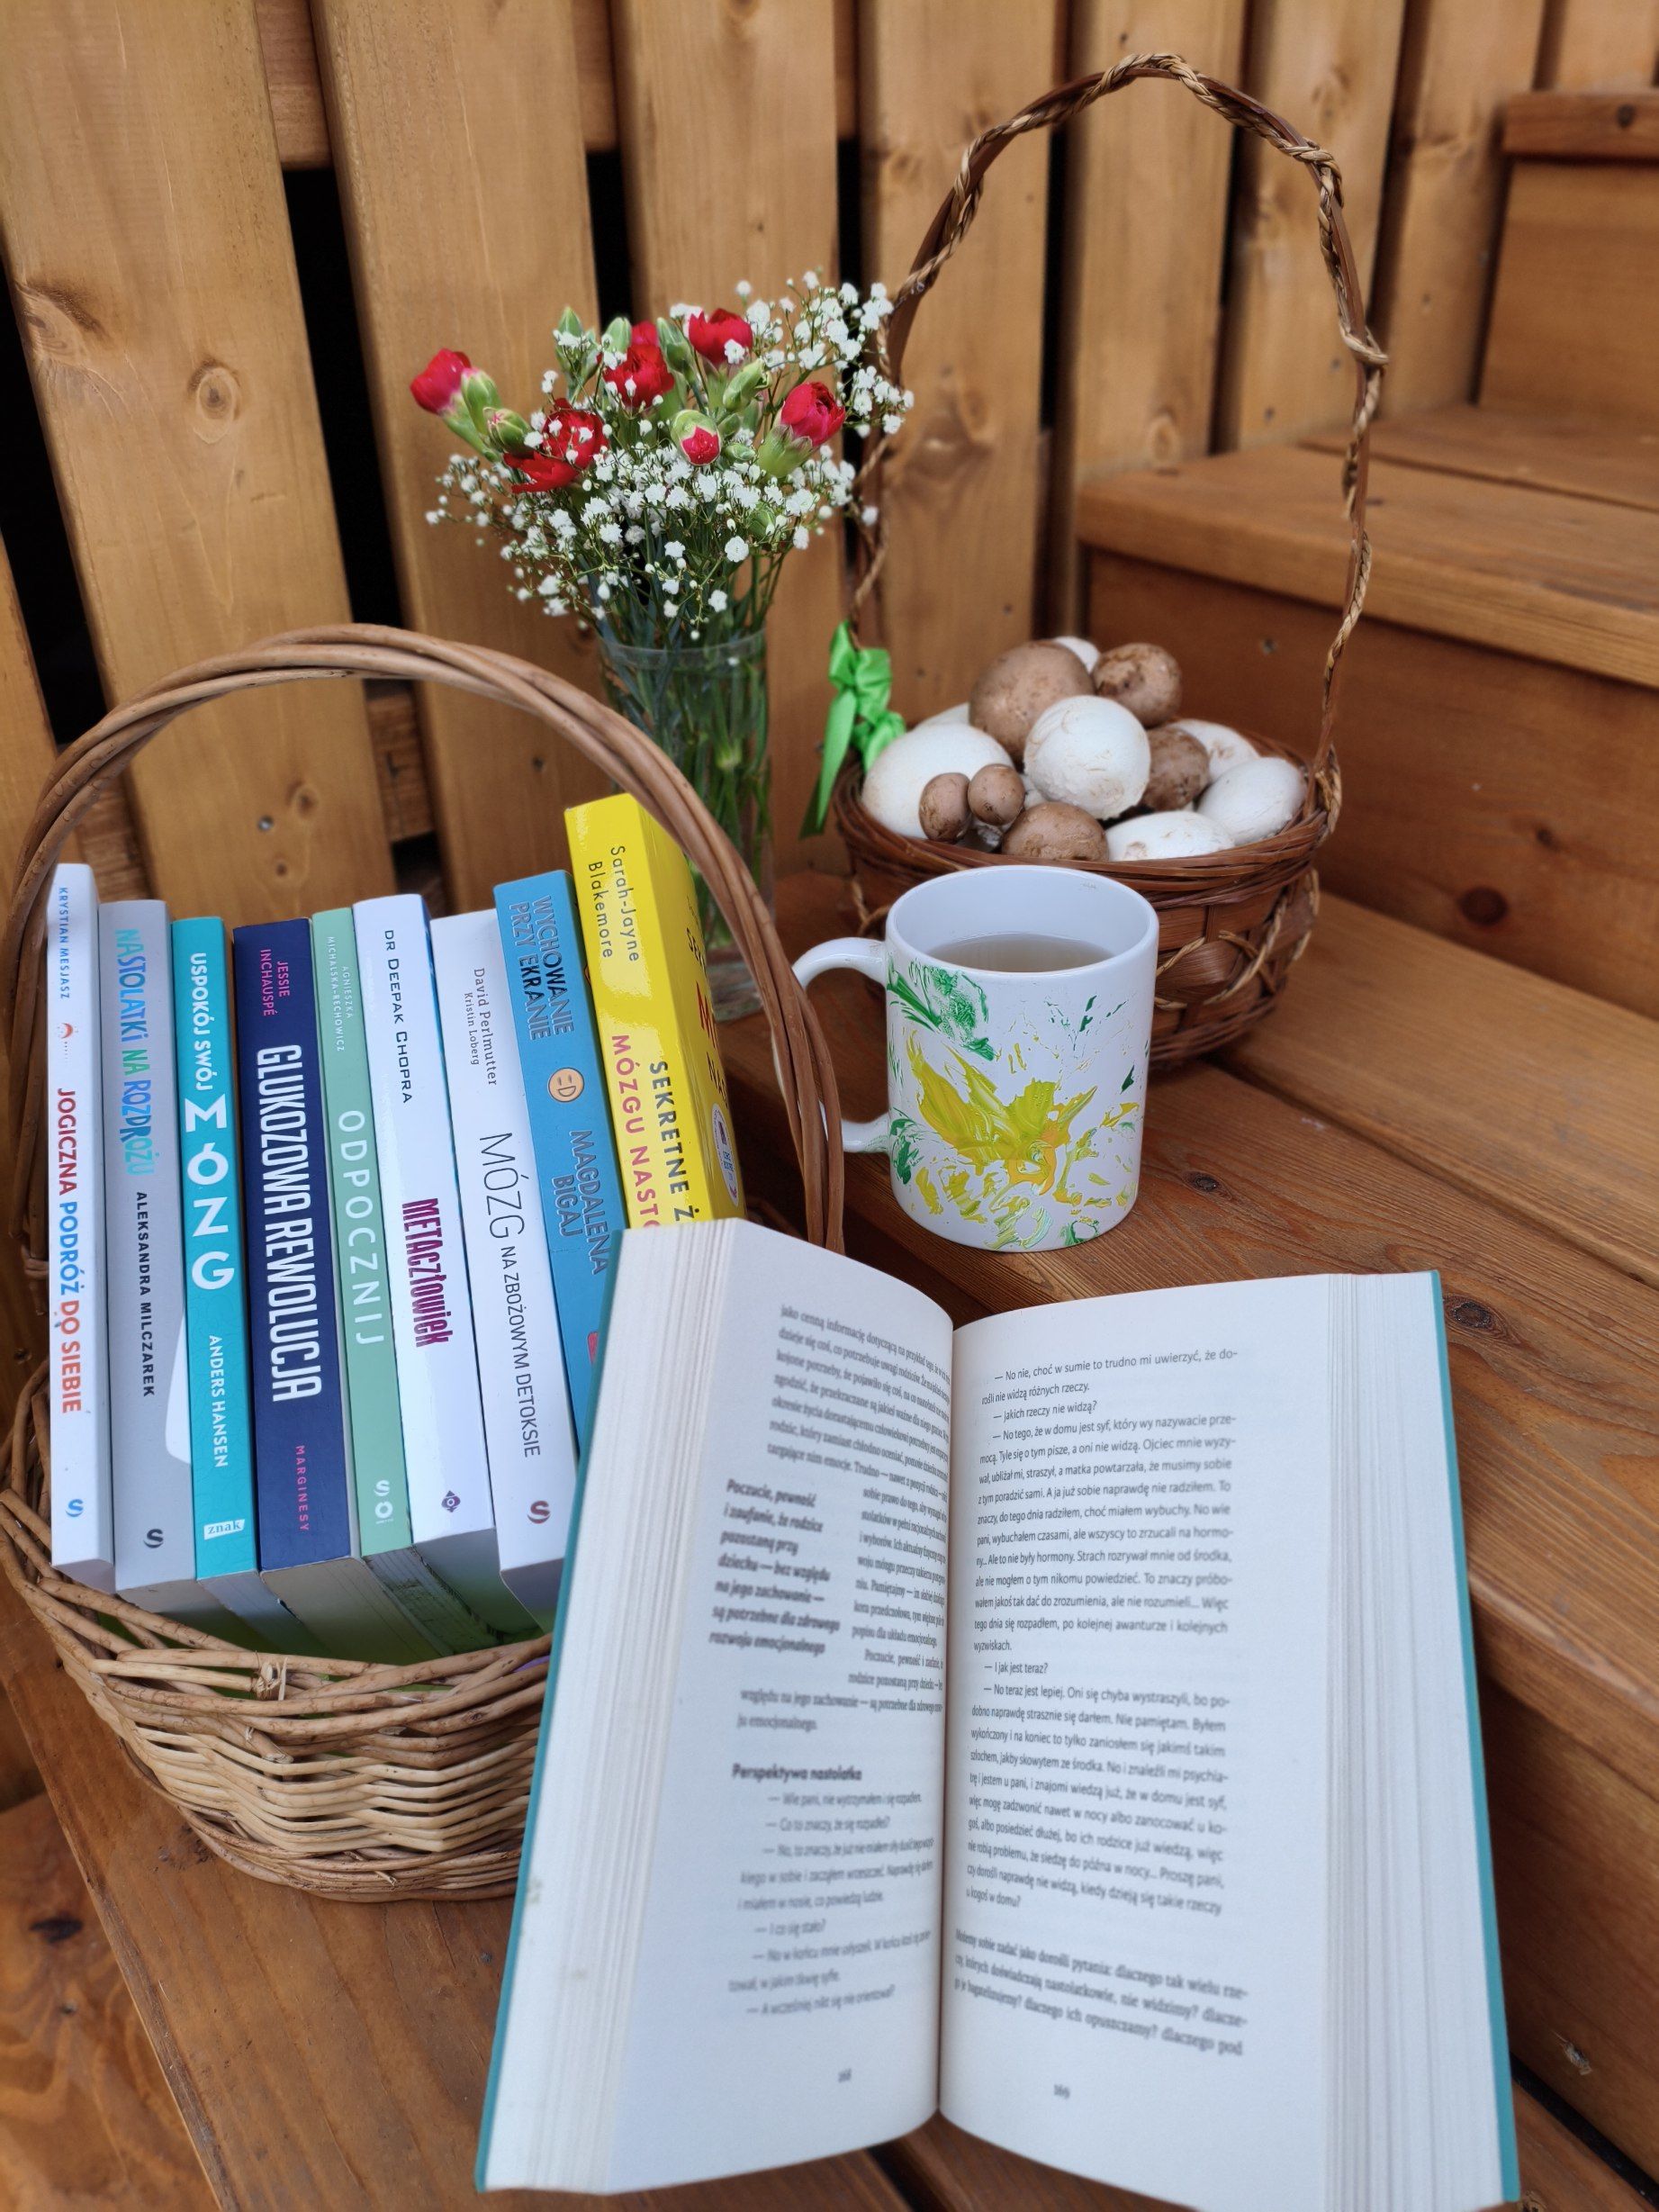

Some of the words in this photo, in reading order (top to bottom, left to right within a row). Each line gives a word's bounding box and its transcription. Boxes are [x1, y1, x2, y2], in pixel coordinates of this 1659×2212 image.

[58, 887, 69, 943] KRYSTIAN
[510, 902, 534, 948] PRZY
[588, 861, 613, 958] Blakemore
[610, 845, 640, 962] Sarah-Jayne
[384, 929, 396, 951] DR
[532, 895, 573, 1036] WYCHOWANIE
[60, 946, 71, 999] MESJASZ
[189, 952, 215, 1035] USPOKÓJ
[260, 949, 278, 1016] INCHAUSPÉ
[277, 960, 290, 997] JESSIE
[326, 936, 345, 1052] MICHALSKA-RECHOWICZ
[342, 966, 352, 1019] AGNIESZKA
[387, 958, 405, 1024] DEEPAK
[474, 967, 488, 1007] David
[519, 953, 551, 1041] EKRANIE
[463, 992, 475, 1030] Kristin
[121, 1050, 150, 1076] NA
[194, 1040, 213, 1091] SWÓJ
[397, 1031, 412, 1104] CHOPRA
[468, 1030, 480, 1065] Loberg
[479, 1009, 498, 1086] Perlmutter
[611, 1035, 646, 1135] MÓZGU
[57, 1088, 77, 1196] JOGICZNA
[119, 1080, 155, 1177] ROZDROŻU
[257, 1044, 313, 1214] GLUKOZOWA
[649, 1061, 690, 1194] SEKRETNE
[185, 1093, 235, 1291] MÓZG
[479, 1131, 529, 1239] MÓZG
[551, 1175, 583, 1238] BIGAJ
[569, 1129, 609, 1275] MAGDALENA
[59, 1202, 85, 1296] PODRÓŻ
[136, 1191, 152, 1296] ALEKSANDRA
[337, 1110, 385, 1345] ODPOCZNIJ
[500, 1245, 517, 1270] NA
[60, 1299, 80, 1335] DO
[262, 1217, 322, 1402] REWOLUCJA
[502, 1274, 530, 1370] ZBOŻOWYM
[61, 1341, 82, 1413] SIEBIE
[140, 1303, 155, 1397] MILCZAREK
[208, 1335, 225, 1398] ANDERS
[1006, 1370, 1016, 1380] No
[1018, 1368, 1031, 1379] nie,
[1033, 1364, 1053, 1377] choć
[1065, 1361, 1091, 1373] sumie
[1093, 1361, 1103, 1370] to
[1105, 1356, 1137, 1369] trudno
[1140, 1354, 1152, 1365] mi
[1155, 1350, 1201, 1365] uwierzyć,
[1205, 1350, 1217, 1361] że
[515, 1374, 540, 1458] DETOKSIE
[982, 1393, 995, 1405] rośli
[995, 1392, 1006, 1402] nie
[1007, 1388, 1027, 1401] widzą
[1029, 1383, 1060, 1397] różnych
[1062, 1383, 1090, 1393] rzeczy.
[1004, 1408, 1025, 1423] Jakich
[1026, 1408, 1050, 1417] rzeczy
[1052, 1404, 1066, 1414] nie
[1067, 1400, 1097, 1415] widzą?
[211, 1401, 229, 1468] HANSEN
[980, 1454, 998, 1466] mocą.
[1013, 1449, 1024, 1462] się
[1031, 1448, 1046, 1460] tym
[1047, 1445, 1070, 1459] pisze,
[1079, 1442, 1093, 1454] oni
[1095, 1442, 1109, 1452] nie
[1111, 1440, 1141, 1454] widzą.
[1143, 1438, 1174, 1452] Ojciec
[1176, 1437, 1203, 1448] mnie
[1003, 1430, 1014, 1440] No
[1015, 1429, 1033, 1441] tego,
[1034, 1426, 1043, 1437] że
[1053, 1424, 1077, 1435] domu
[1079, 1422, 1095, 1435] jest
[1096, 1419, 1111, 1433] syf,
[1113, 1418, 1138, 1431] który
[1139, 1420, 1153, 1431] wy
[1155, 1417, 1207, 1429] nazywacie
[295, 1445, 310, 1532] MARGINESY
[979, 1472, 991, 1484] wał,
[992, 1469, 1013, 1482] ubliżał
[1026, 1466, 1057, 1479] straszył,
[1065, 1464, 1092, 1475] matka
[1093, 1461, 1146, 1476] powtarzała,
[1149, 1461, 1160, 1472] że
[1162, 1461, 1201, 1472] musimy
[1204, 1458, 1232, 1470] sobie
[982, 1495, 994, 1506] tym
[995, 1489, 1024, 1504] poradzić
[1025, 1487, 1045, 1500] sami.
[1053, 1487, 1061, 1500] ja
[1062, 1486, 1076, 1499] już
[1077, 1485, 1101, 1496] sobie
[1103, 1483, 1150, 1497] naprawdę
[1152, 1482, 1167, 1493] nie
[1219, 1480, 1231, 1492] To
[208, 1520, 241, 1534] znak
[977, 1515, 998, 1525] znaczy,
[999, 1511, 1009, 1522] do
[1009, 1512, 1026, 1524] tego
[1027, 1509, 1044, 1520] dnia
[1045, 1507, 1082, 1519] radziłem,
[1084, 1505, 1106, 1518] choć
[1108, 1505, 1143, 1516] miałem
[1194, 1503, 1210, 1515] No
[992, 1531, 1036, 1546] wybuchałem
[1037, 1529, 1072, 1541] czasami,
[1073, 1528, 1086, 1540] ale
[1088, 1530, 1125, 1541] wszyscy
[1127, 1529, 1137, 1539] to
[1138, 1527, 1176, 1539] zrzucali
[1178, 1529, 1191, 1538] na
[974, 1639, 1012, 1654] wyzwiskach.
[998, 1662, 1009, 1675] jak
[1009, 1662, 1024, 1676] jest
[1024, 1662, 1048, 1674] teraz?
[732, 1763, 809, 1783] Perspektywa
[810, 1766, 862, 1781] nastolatka
